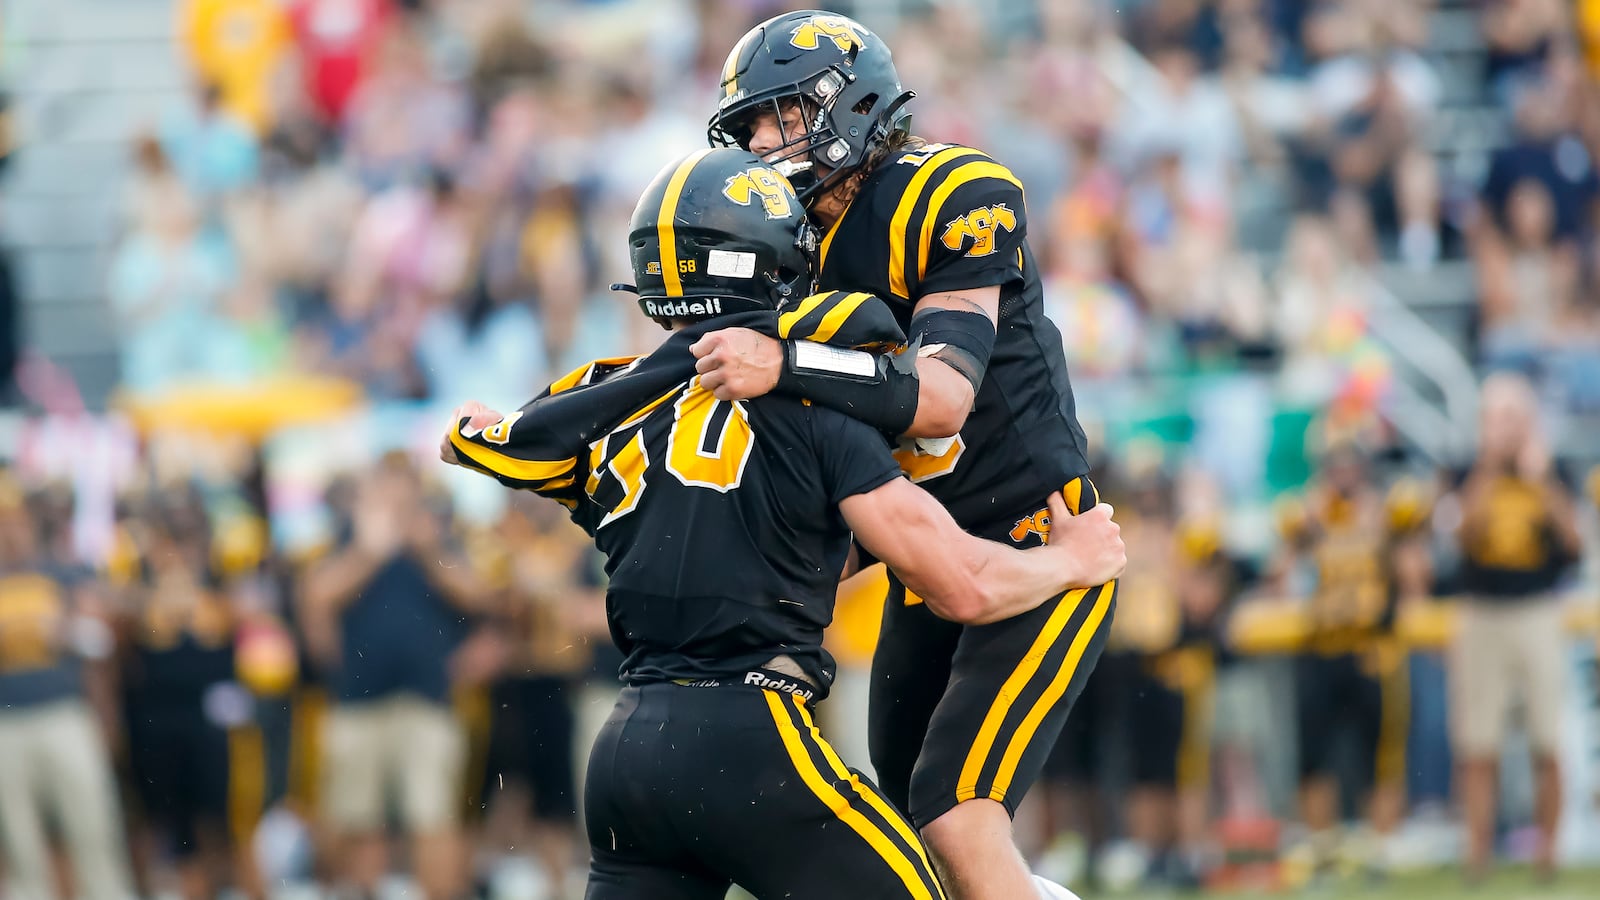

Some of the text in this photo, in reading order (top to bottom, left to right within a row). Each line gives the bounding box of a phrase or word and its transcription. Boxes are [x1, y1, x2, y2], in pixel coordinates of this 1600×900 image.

[679, 259, 697, 273] 58
[646, 298, 722, 316] Riddell
[744, 671, 813, 701] Riddell
